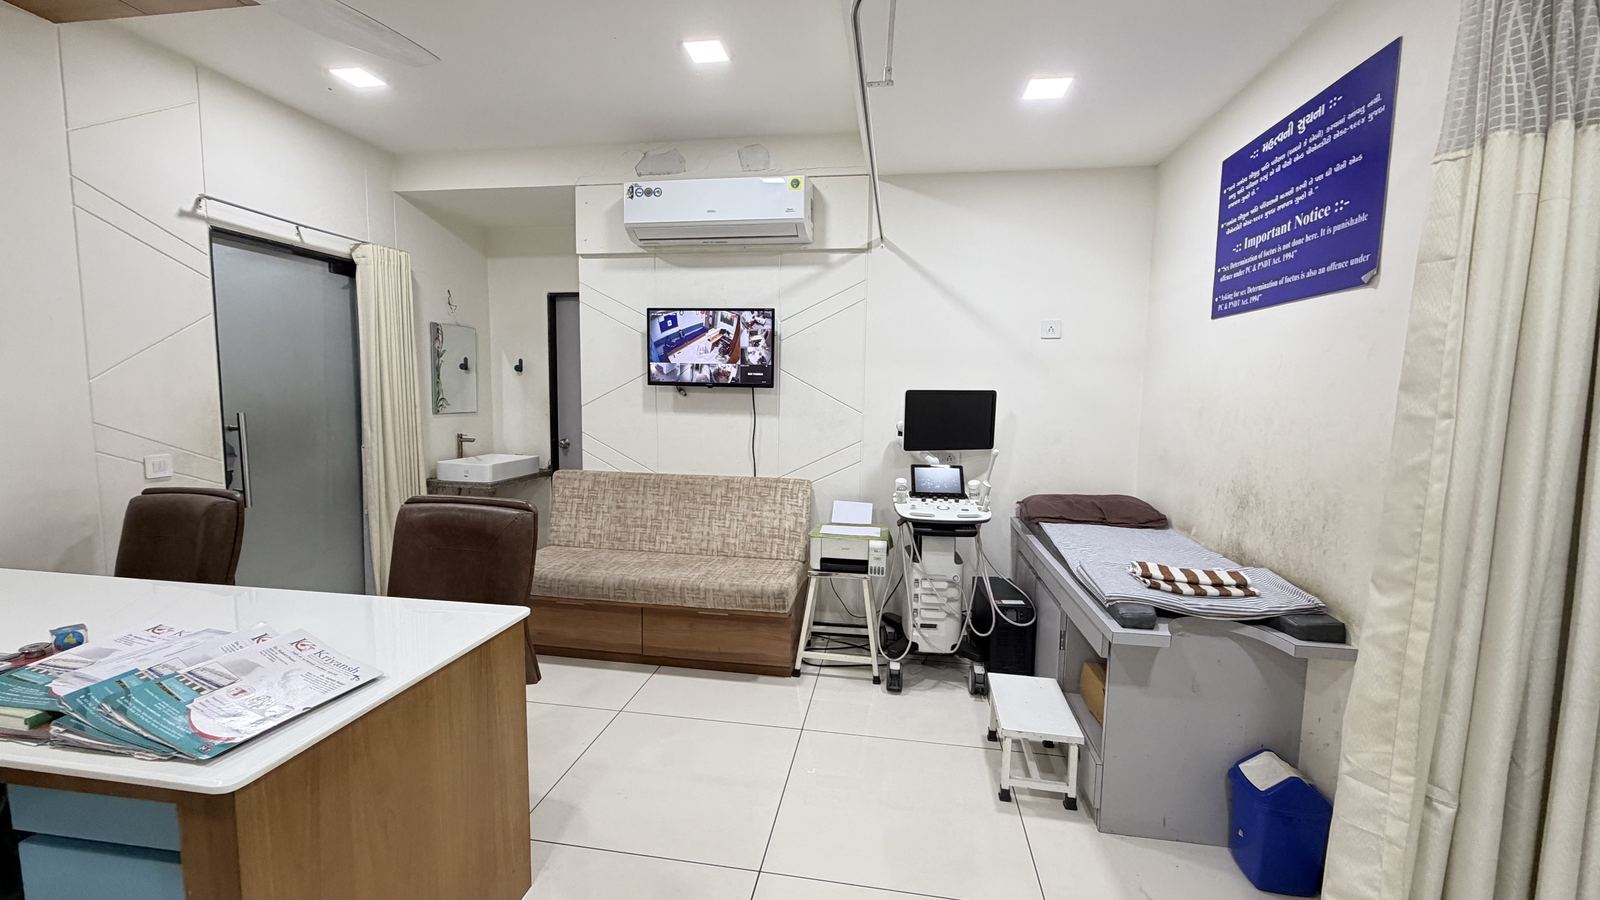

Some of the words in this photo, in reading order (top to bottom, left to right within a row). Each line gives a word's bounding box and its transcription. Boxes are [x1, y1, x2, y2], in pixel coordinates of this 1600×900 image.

[1244, 220, 1291, 249] Important
[1294, 206, 1331, 229] Notice
[1291, 238, 1304, 247] done
[1305, 233, 1319, 242] here.
[1332, 212, 1368, 235] punishable
[1306, 269, 1317, 278] also
[1326, 261, 1349, 272] offence
[1350, 254, 1371, 266] under
